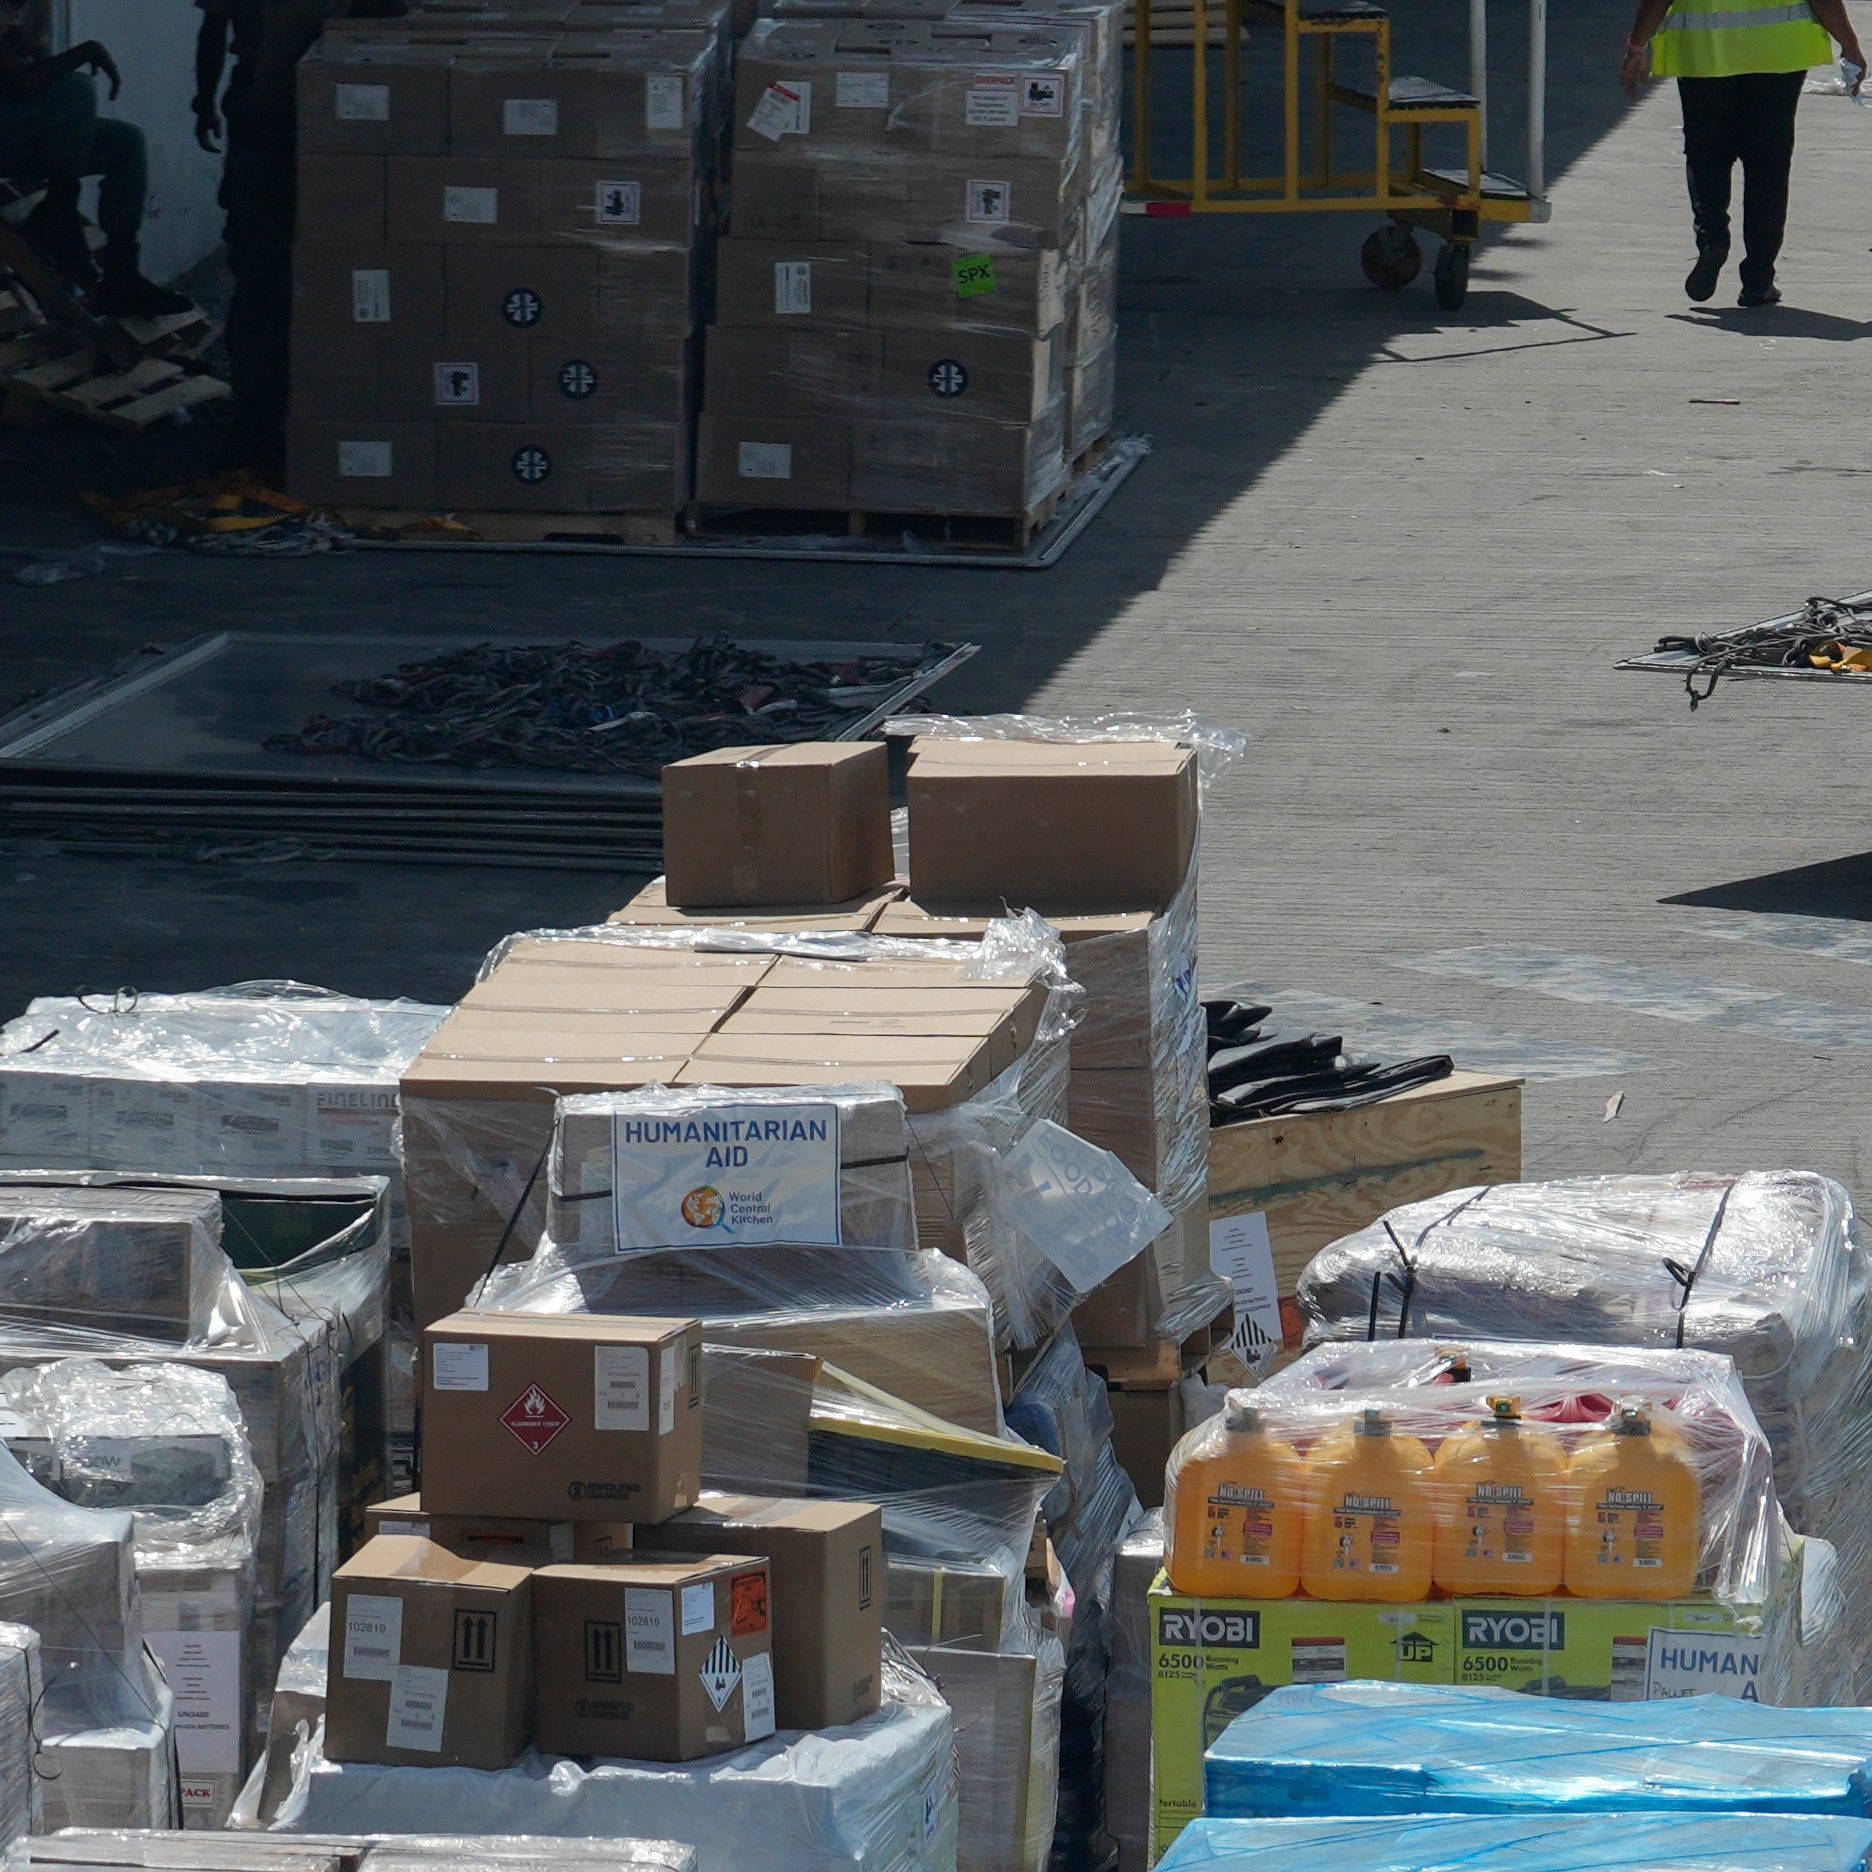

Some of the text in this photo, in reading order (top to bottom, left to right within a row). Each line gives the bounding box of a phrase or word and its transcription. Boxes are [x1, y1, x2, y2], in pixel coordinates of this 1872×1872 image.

[957, 264, 990, 284] SPX
[625, 1120, 827, 1144] HUMANITARIAN
[705, 1146, 749, 1169] AID
[728, 1191, 763, 1202] World
[730, 1202, 771, 1214] Central
[731, 1214, 774, 1225] Kitchen
[532, 1441, 539, 1450] 3
[1163, 1614, 1253, 1642] RYOBI
[1467, 1616, 1558, 1643] RYOBI
[1158, 1652, 1204, 1670] 6500
[1399, 1645, 1432, 1662] UP
[1462, 1655, 1508, 1673] 6500
[1158, 1670, 1181, 1680] 8125
